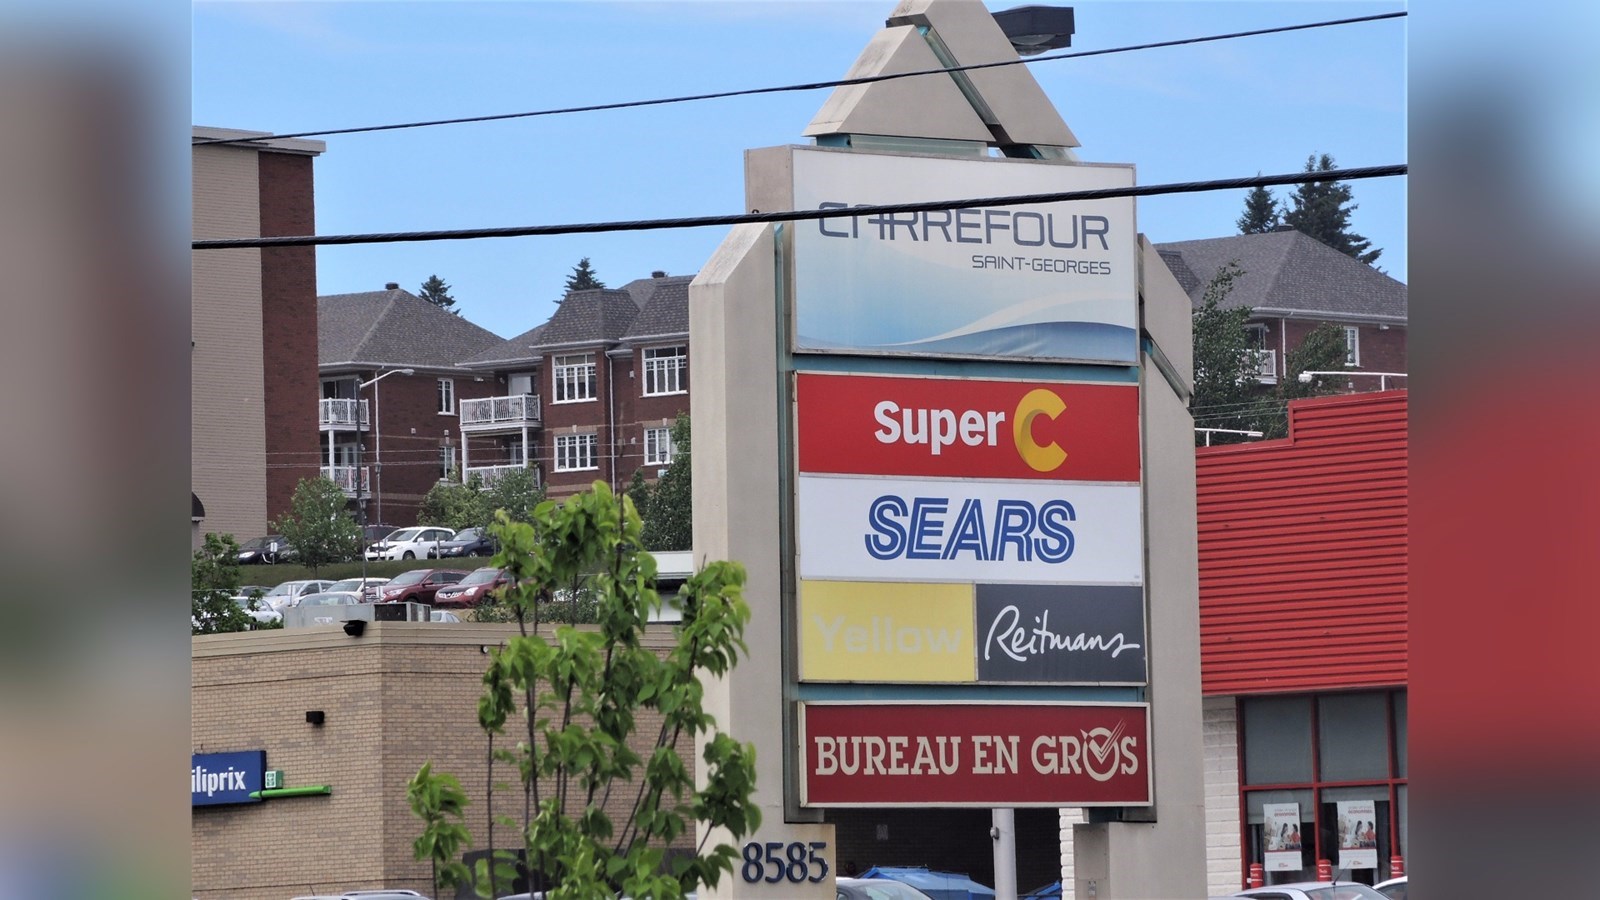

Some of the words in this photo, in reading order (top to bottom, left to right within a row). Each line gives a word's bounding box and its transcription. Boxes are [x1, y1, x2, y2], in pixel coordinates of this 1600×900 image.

[818, 201, 1110, 250] CARREFOUR
[971, 254, 1111, 275] SAINT-GEORGES
[873, 400, 1005, 456] Super
[1012, 388, 1068, 472] C
[864, 494, 1076, 564] SEARS
[811, 614, 962, 654] Yellow
[984, 604, 1141, 662] Reitmans
[814, 736, 961, 776] BUREAU
[971, 735, 1020, 775] EN
[1031, 720, 1139, 782] GROS
[741, 841, 829, 884] 8585
